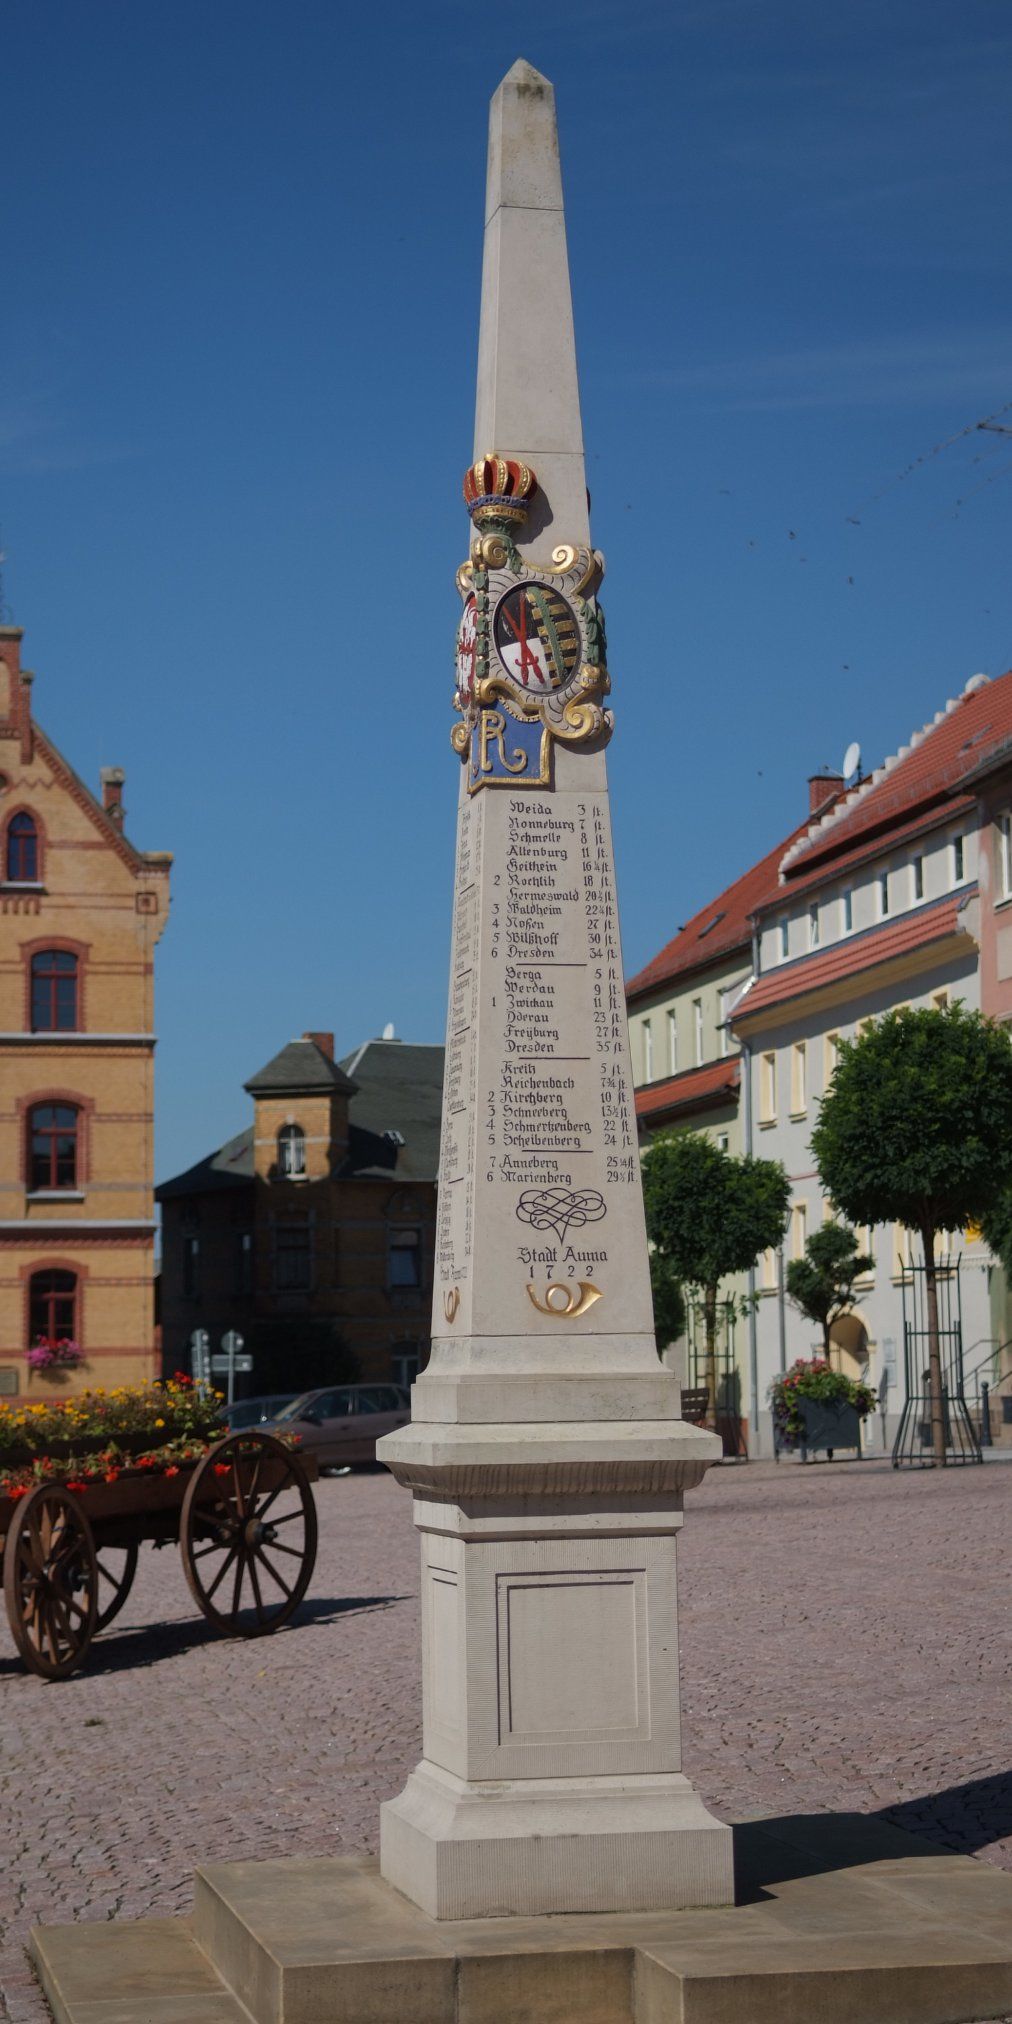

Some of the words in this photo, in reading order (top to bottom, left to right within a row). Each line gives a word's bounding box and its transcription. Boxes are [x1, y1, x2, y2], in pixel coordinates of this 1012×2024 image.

[510, 800, 552, 814] Weida
[578, 804, 585, 815] 3
[579, 819, 585, 830] 7
[581, 833, 587, 844] 8
[582, 848, 589, 858] 11
[493, 875, 500, 886] 2
[584, 876, 593, 886] 18
[491, 904, 499, 914] 3
[507, 900, 562, 916] Waldheim
[492, 919, 499, 928] 4
[587, 919, 599, 929] 27
[492, 933, 500, 942] 5
[588, 934, 600, 944] 30
[491, 948, 498, 958] 6
[507, 945, 554, 958] Dresden
[590, 948, 603, 958] 34
[505, 966, 542, 982] Berga
[595, 969, 602, 979] 5
[505, 980, 555, 994] Werdau
[594, 984, 601, 995] 9
[492, 997, 496, 1007] 1
[594, 998, 601, 1008] 11
[594, 1012, 606, 1023] 23
[596, 1026, 608, 1037] 27
[505, 1040, 554, 1053] Dresden
[596, 1041, 610, 1052] 35
[601, 1063, 606, 1073] 5
[501, 1076, 574, 1089] Reichenbach
[488, 1091, 494, 1102] 2
[500, 1091, 563, 1106] Kirchberg
[601, 1092, 611, 1102] 10
[488, 1105, 495, 1116] 3
[503, 1104, 567, 1120] Schneeberg
[486, 1119, 495, 1130] 4
[604, 1120, 615, 1131] 22
[488, 1134, 495, 1145] 5
[503, 1134, 581, 1148] Scheibenberg
[604, 1134, 617, 1146] 24
[489, 1156, 496, 1168] 7
[487, 1172, 493, 1182] 6
[501, 1169, 571, 1185] Marienberg
[517, 1247, 557, 1264] Stadt
[562, 1246, 608, 1262] Auma
